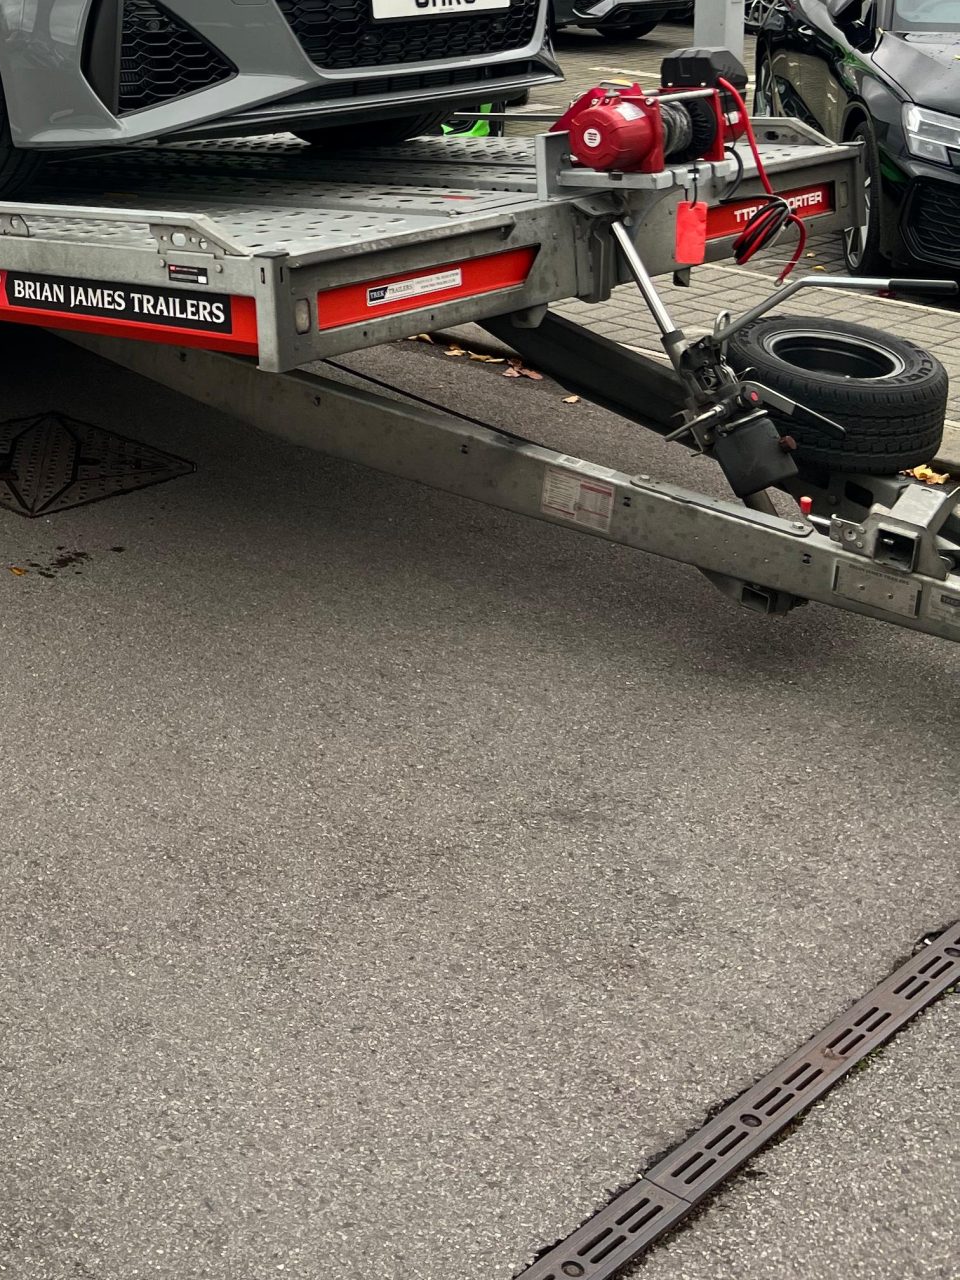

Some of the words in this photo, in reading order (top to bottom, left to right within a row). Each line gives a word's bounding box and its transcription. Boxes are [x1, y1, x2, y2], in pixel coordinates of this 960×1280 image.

[13, 279, 65, 304] BRIAN
[69, 285, 127, 312] JAMES
[130, 292, 226, 325] TRAILERS
